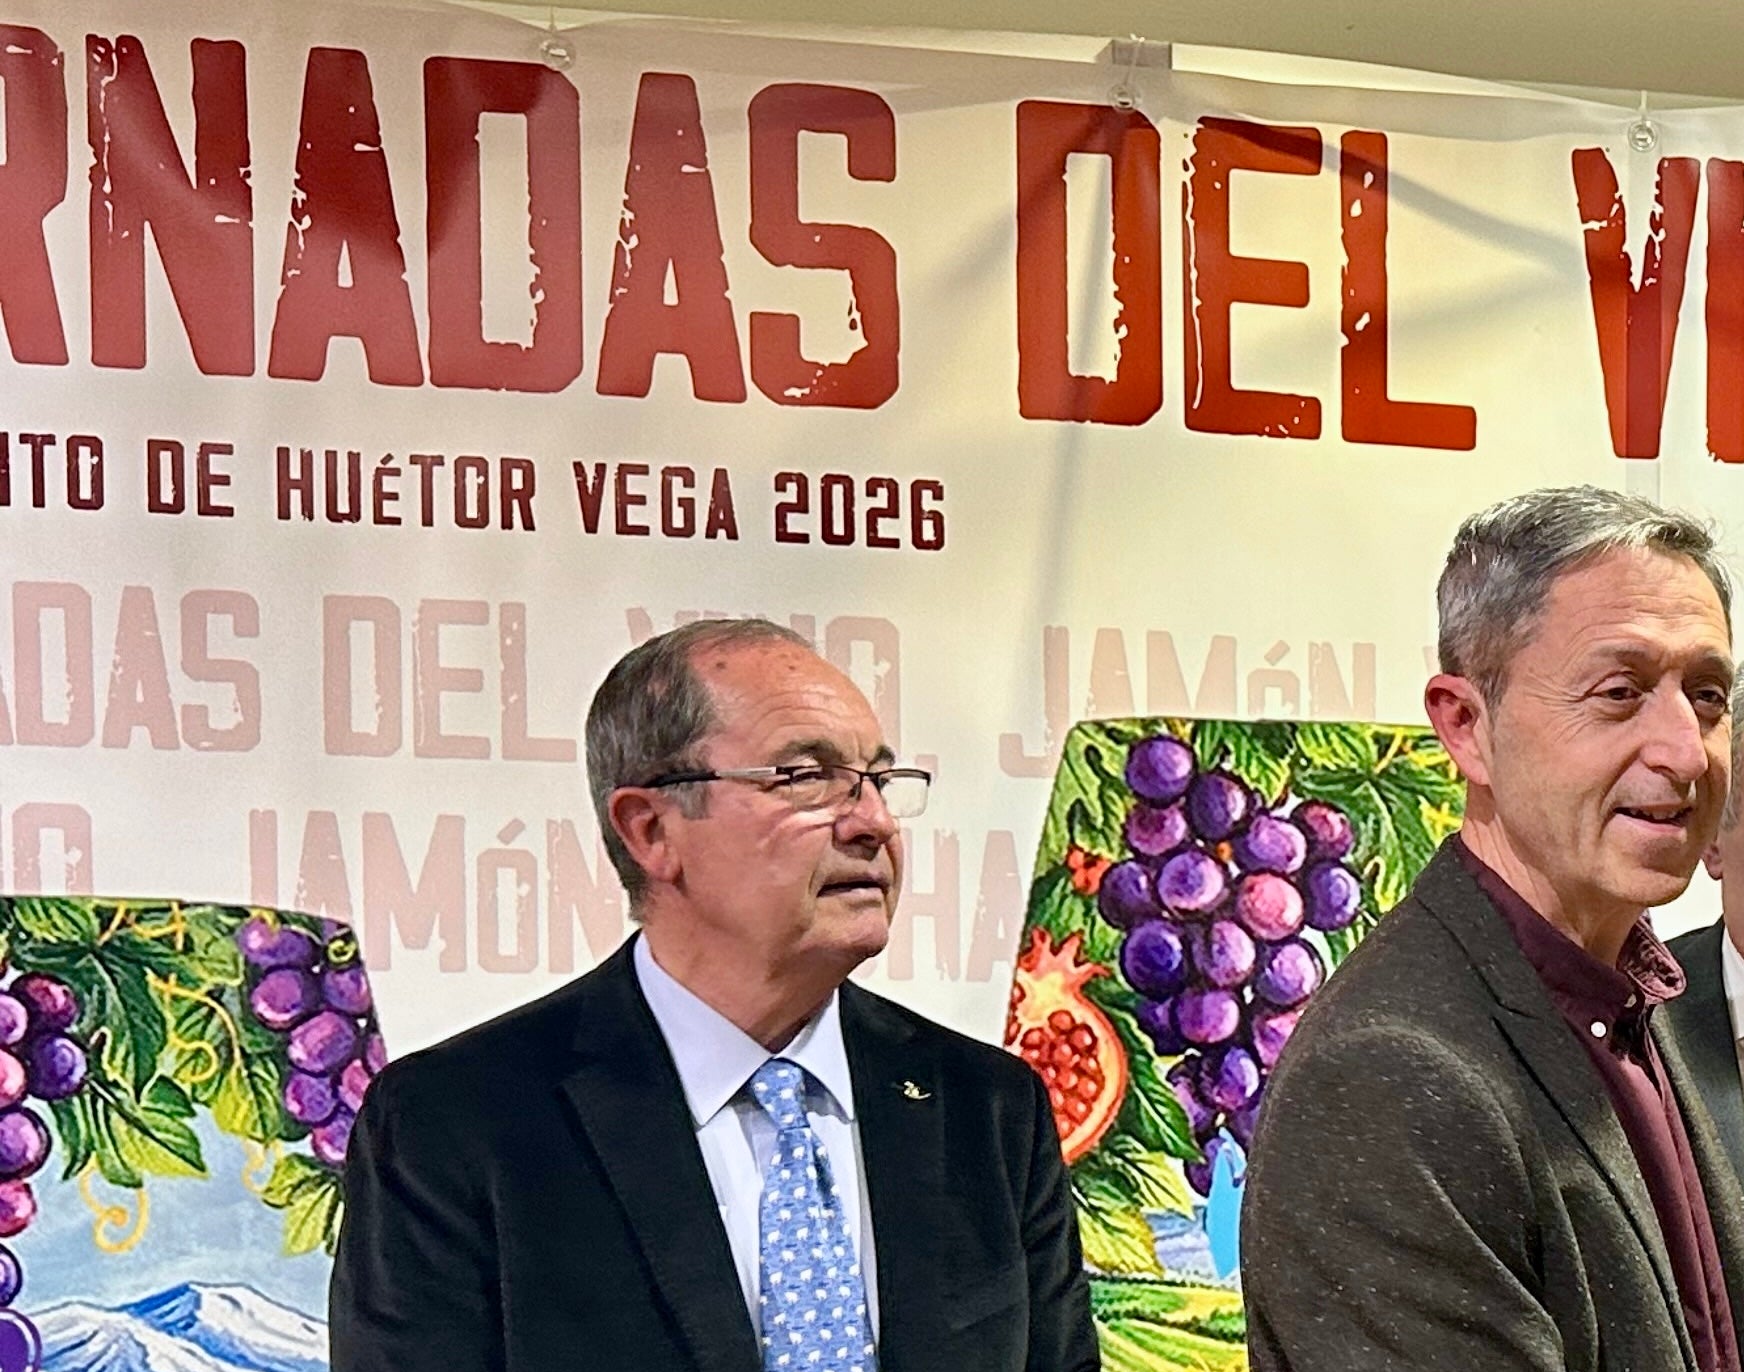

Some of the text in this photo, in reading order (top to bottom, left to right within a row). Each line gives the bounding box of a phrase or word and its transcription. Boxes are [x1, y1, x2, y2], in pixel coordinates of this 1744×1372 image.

[1016, 100, 1477, 450] DEL
[0, 432, 104, 510] TO
[148, 439, 234, 517] DE
[573, 462, 738, 540] VEGA
[775, 472, 945, 550] 2026
[0, 581, 260, 752] DAS
[322, 594, 577, 762] DEL
